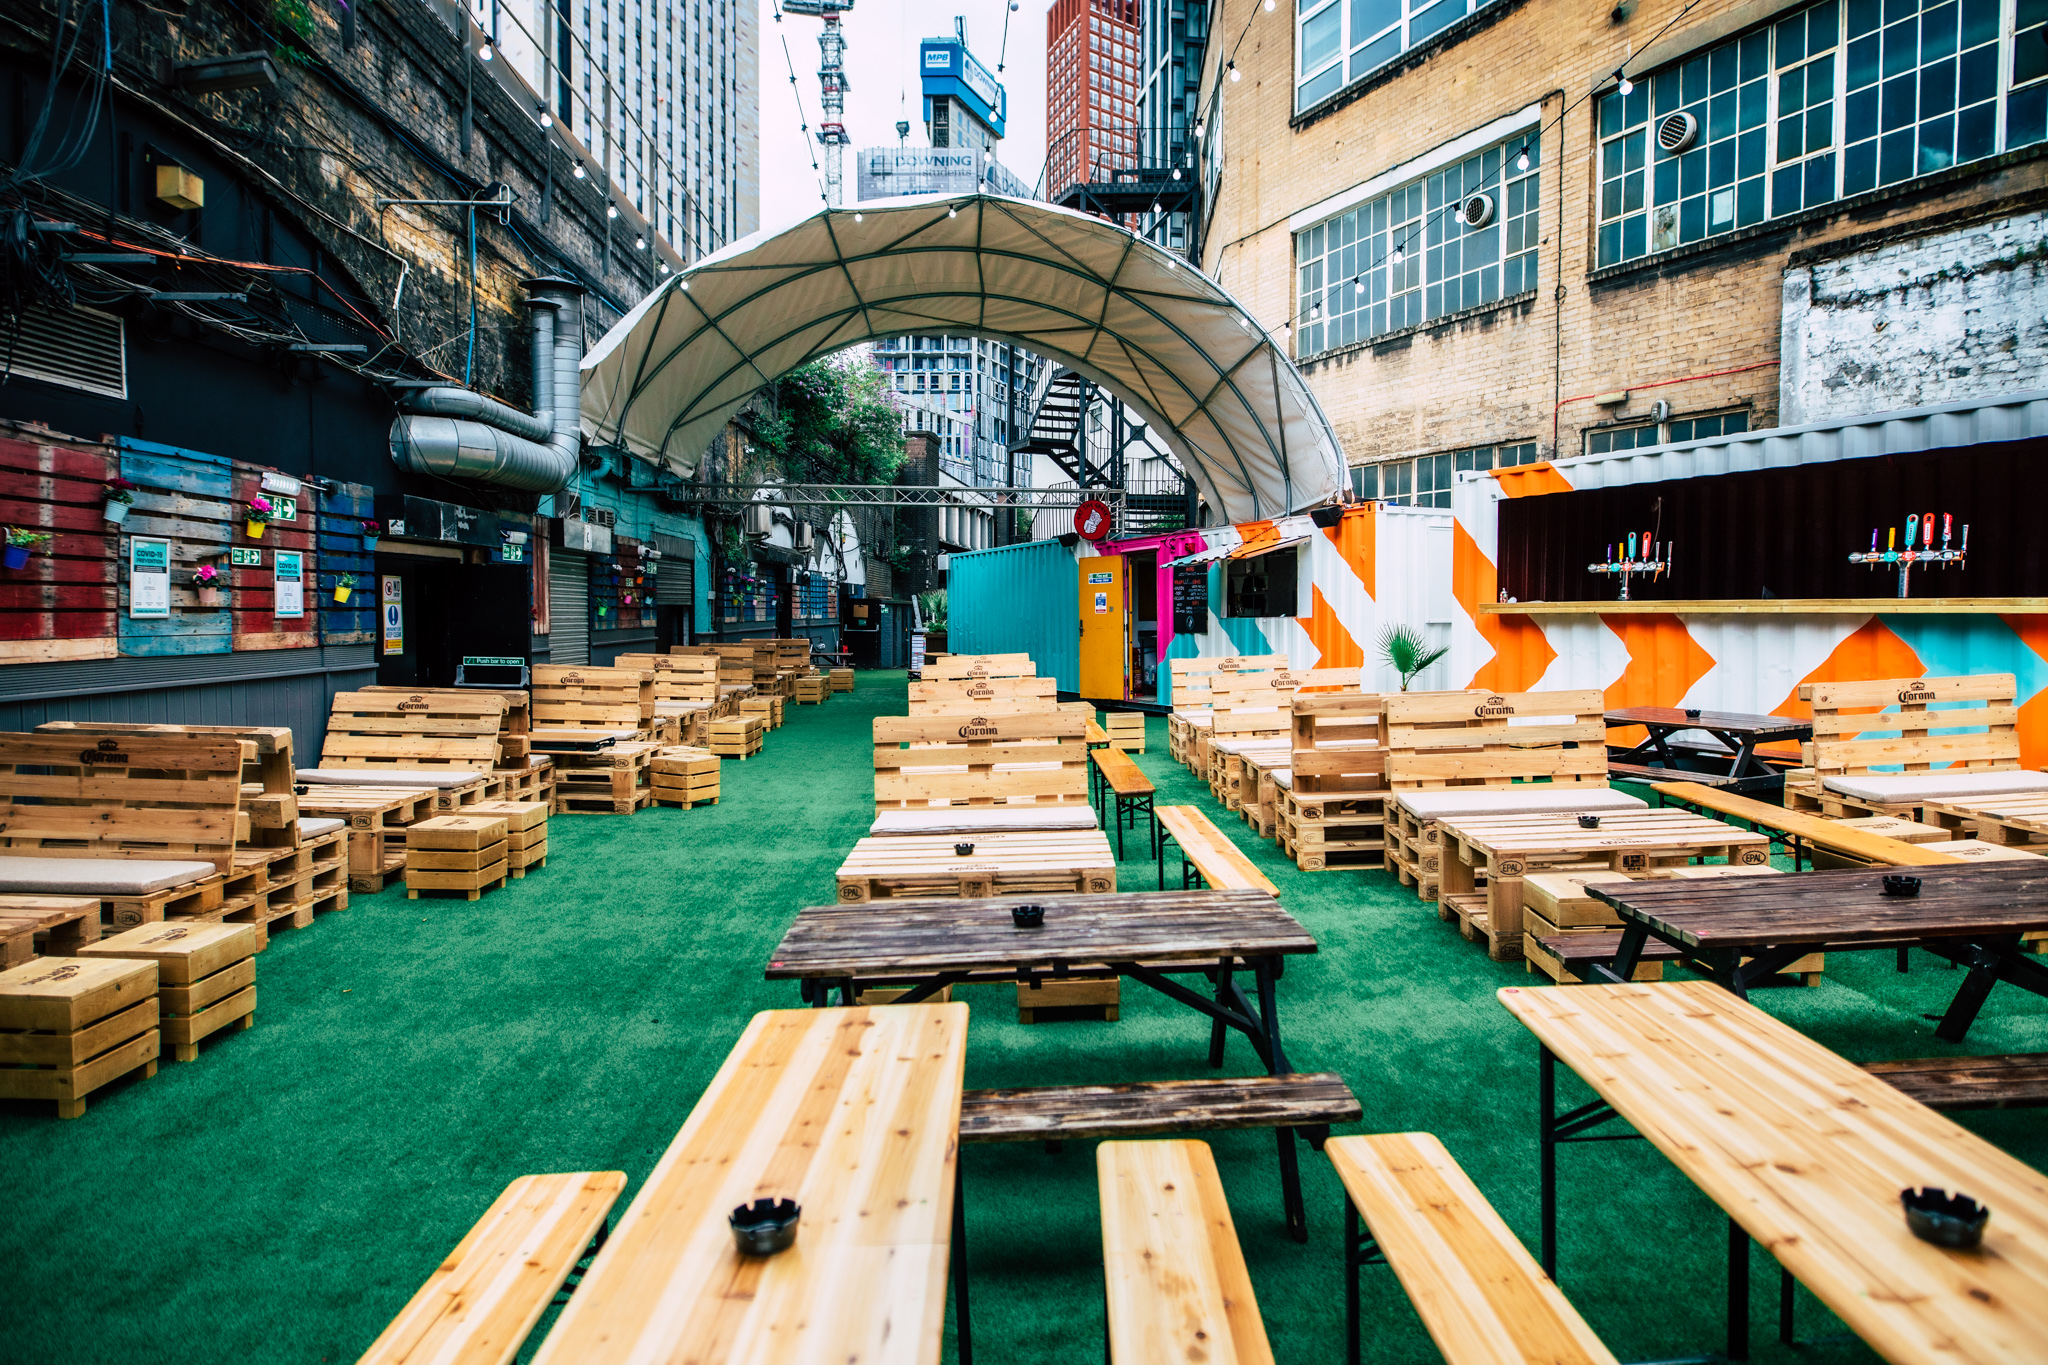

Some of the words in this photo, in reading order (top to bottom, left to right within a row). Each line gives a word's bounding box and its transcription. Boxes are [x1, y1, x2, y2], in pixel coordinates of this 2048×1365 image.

[927, 53, 949, 61] MPB
[895, 155, 972, 167] DOWNING
[921, 167, 972, 177] students
[1082, 502, 1093, 510] THE
[136, 550, 164, 558] COVID-19
[1218, 662, 1240, 670] Corona
[967, 669, 989, 677] Corona
[560, 676, 585, 684] Corona
[1271, 678, 1299, 688] Corona
[966, 688, 995, 698] Corona
[1898, 690, 1936, 704] Corona
[397, 701, 430, 712] Corona
[1474, 705, 1515, 718] Corona
[958, 725, 998, 739] Corona
[80, 749, 129, 766] Corona
[1746, 853, 1762, 862] EPAL
[1502, 864, 1519, 872] EPAL
[1091, 881, 1107, 890] EPAL
[843, 888, 860, 897] EPAL
[121, 912, 139, 923] EPAL
